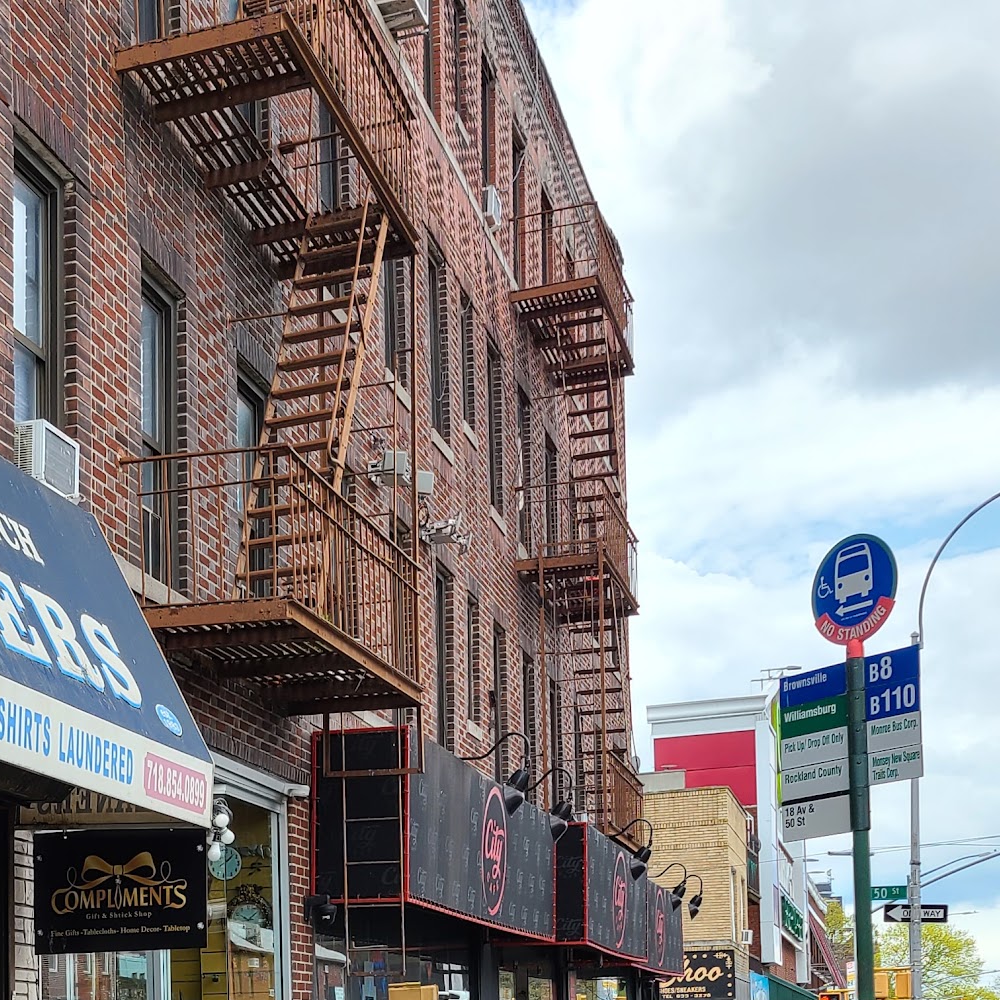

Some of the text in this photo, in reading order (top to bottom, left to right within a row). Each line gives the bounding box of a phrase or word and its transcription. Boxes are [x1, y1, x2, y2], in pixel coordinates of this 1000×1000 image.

[820, 620, 835, 637] NO
[837, 604, 887, 641] STANDING
[869, 656, 893, 683] B8
[783, 672, 828, 692] Brownsville
[870, 683, 916, 715] B110
[784, 703, 837, 723] Williamsburg
[871, 718, 918, 735] Monroe Bus Corp.
[785, 741, 796, 753] Pick
[808, 738, 820, 749] Drop
[822, 734, 830, 745] Off
[831, 732, 844, 744] Only
[59, 720, 134, 785] LAUNDERED
[147, 760, 205, 808] 718.854.0899
[872, 750, 920, 767] Monsey New Square
[785, 765, 843, 784] Rockland County
[887, 768, 899, 779] Corp.
[785, 803, 815, 817] 18 Av &
[785, 816, 806, 828] 50 St
[485, 818, 505, 879] City
[51, 882, 187, 915] COMPLIMENTS
[874, 887, 899, 899] 50 St
